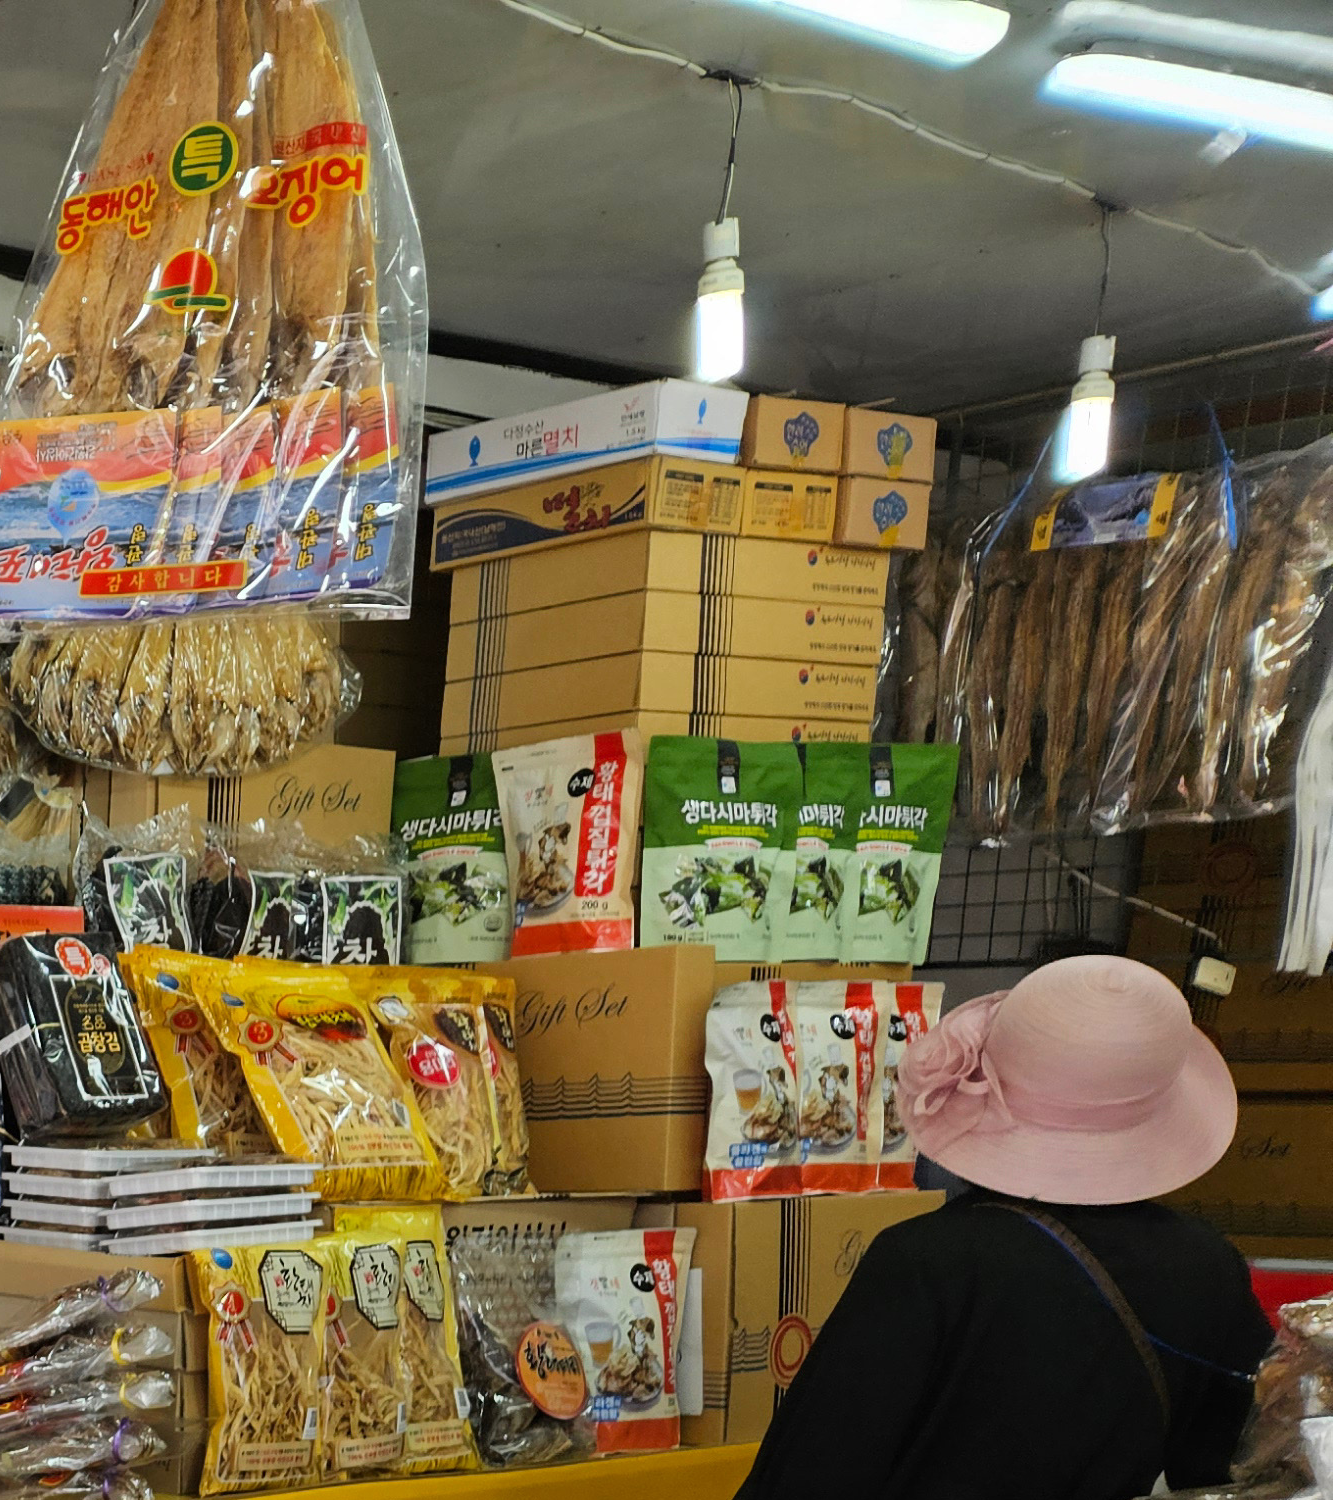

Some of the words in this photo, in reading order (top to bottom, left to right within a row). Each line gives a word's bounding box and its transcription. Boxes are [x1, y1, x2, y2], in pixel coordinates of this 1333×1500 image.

[181, 133, 224, 181] 특
[243, 154, 368, 228] 오징어
[55, 175, 158, 255] 동해안
[106, 569, 223, 592] 감사합니다
[681, 799, 778, 828] 생다시마튀각
[859, 804, 928, 832] 시마튀각
[77, 1031, 121, 1053] 곱창김
